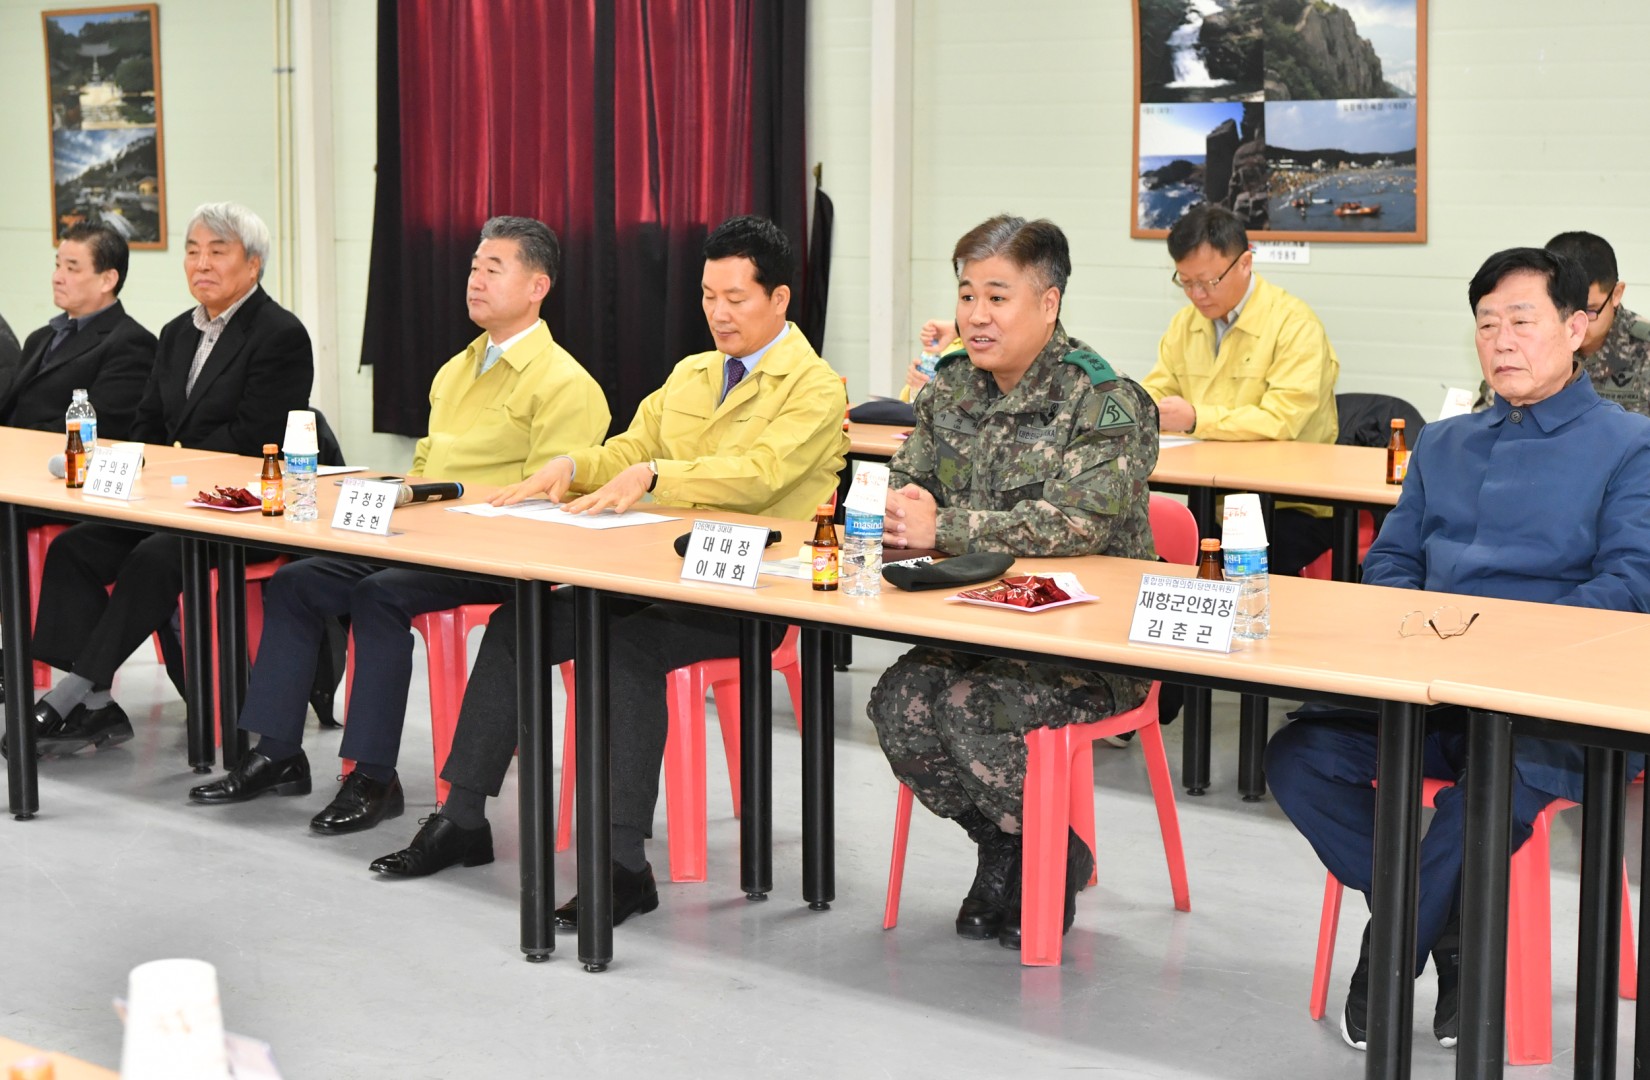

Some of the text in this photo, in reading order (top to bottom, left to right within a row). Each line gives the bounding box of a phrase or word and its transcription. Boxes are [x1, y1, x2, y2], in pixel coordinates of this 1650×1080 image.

[349, 490, 386, 509] 구청장
[702, 536, 750, 557] 대대장
[695, 559, 745, 581] 이재화
[1138, 590, 1234, 618] 재향군인회장
